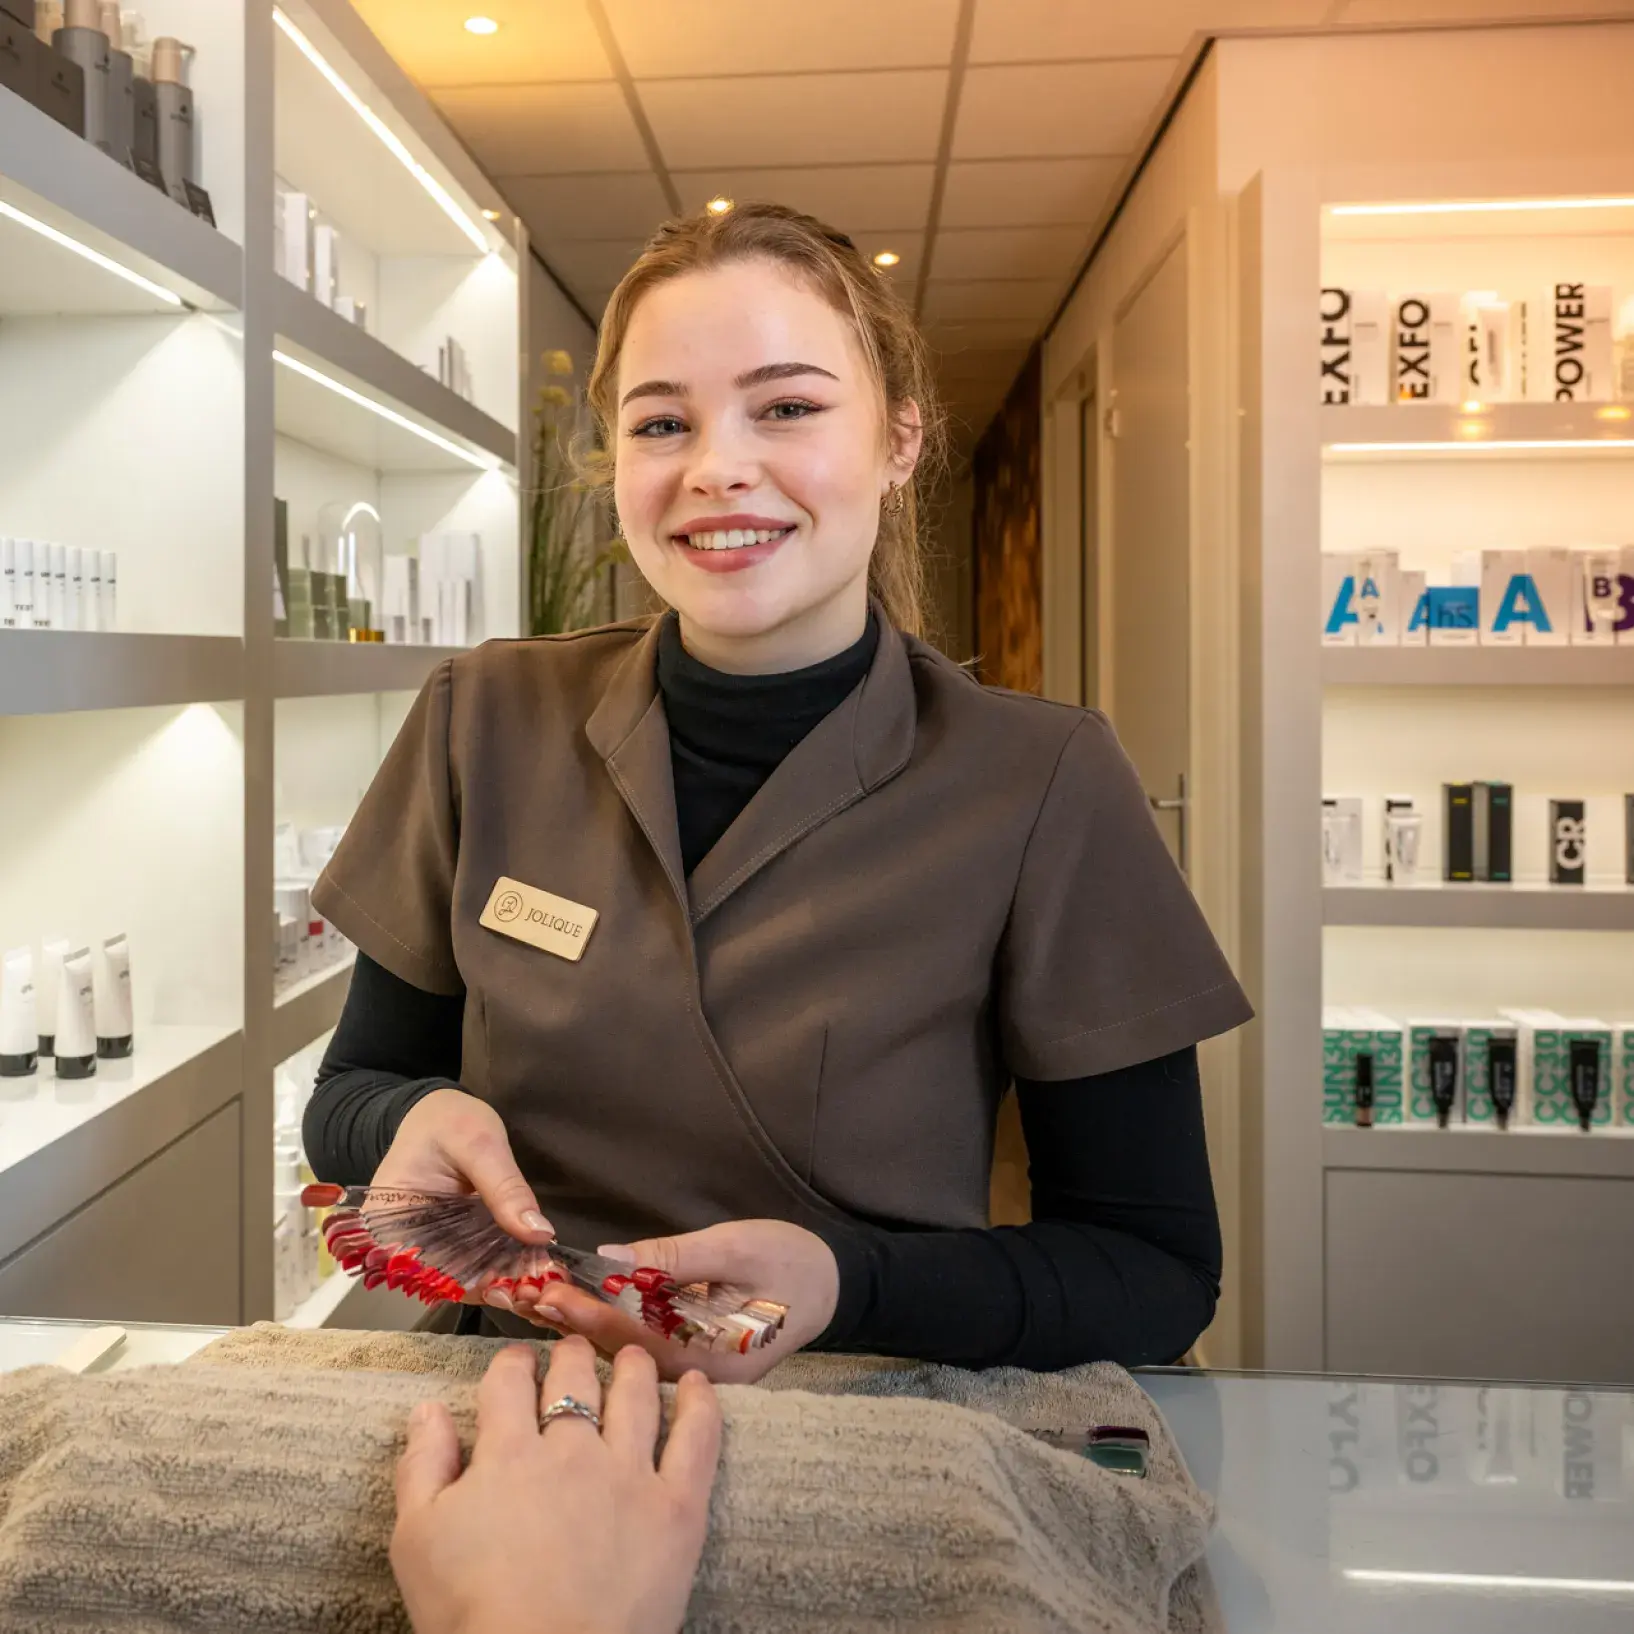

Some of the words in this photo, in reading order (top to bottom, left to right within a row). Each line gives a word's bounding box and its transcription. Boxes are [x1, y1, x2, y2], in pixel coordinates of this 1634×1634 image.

[1399, 300, 1429, 398] EXFO
[1491, 574, 1553, 633] A
[1593, 576, 1612, 598] B
[525, 908, 583, 938] JOLIQUE
